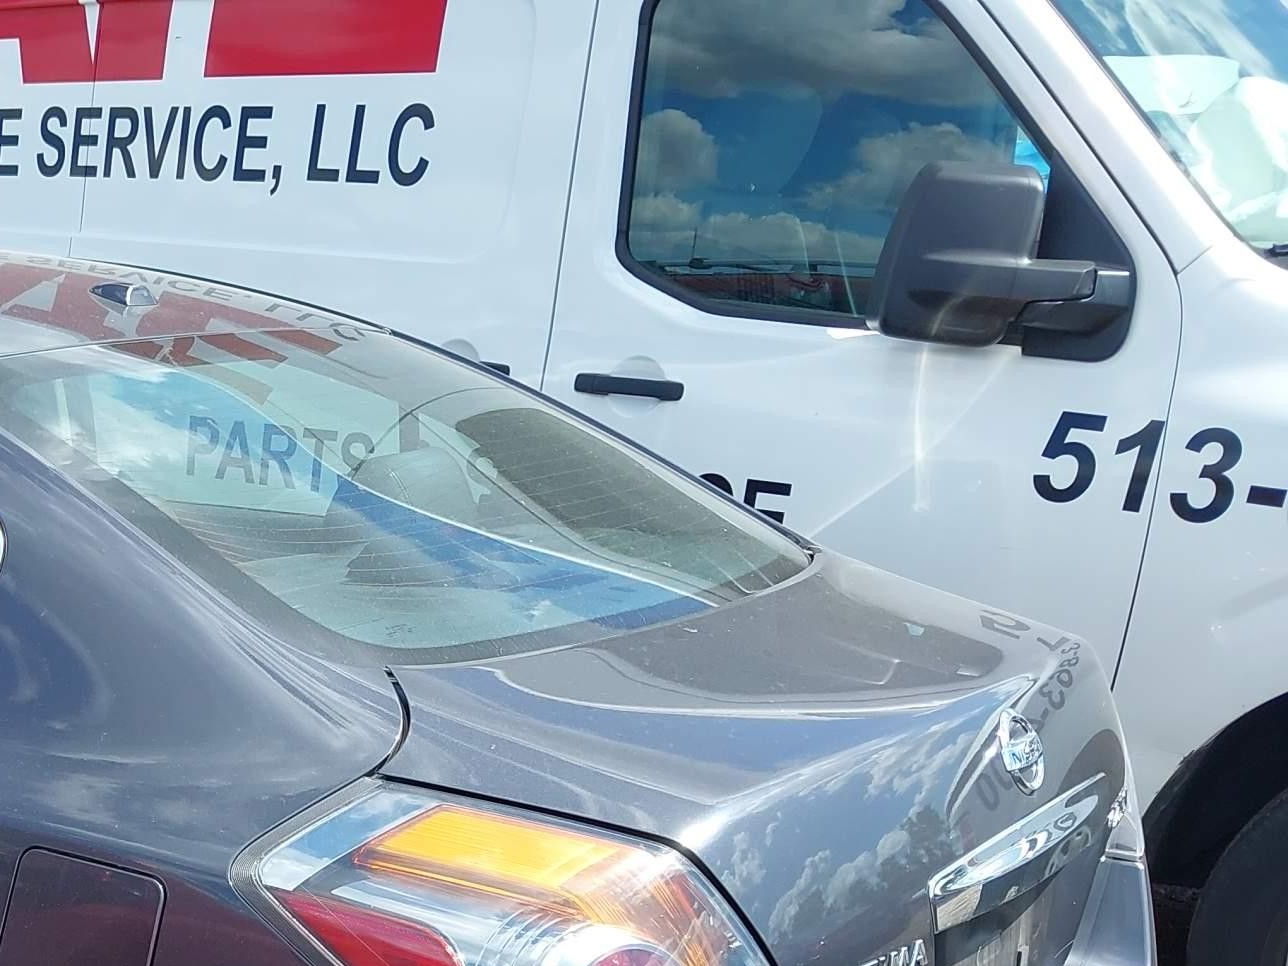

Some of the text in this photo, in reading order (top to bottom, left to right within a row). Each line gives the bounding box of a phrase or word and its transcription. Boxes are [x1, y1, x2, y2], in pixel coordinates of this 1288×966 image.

[36, 105, 283, 196] SERVICE,
[306, 103, 436, 187] LLC
[186, 415, 375, 493] PARTS
